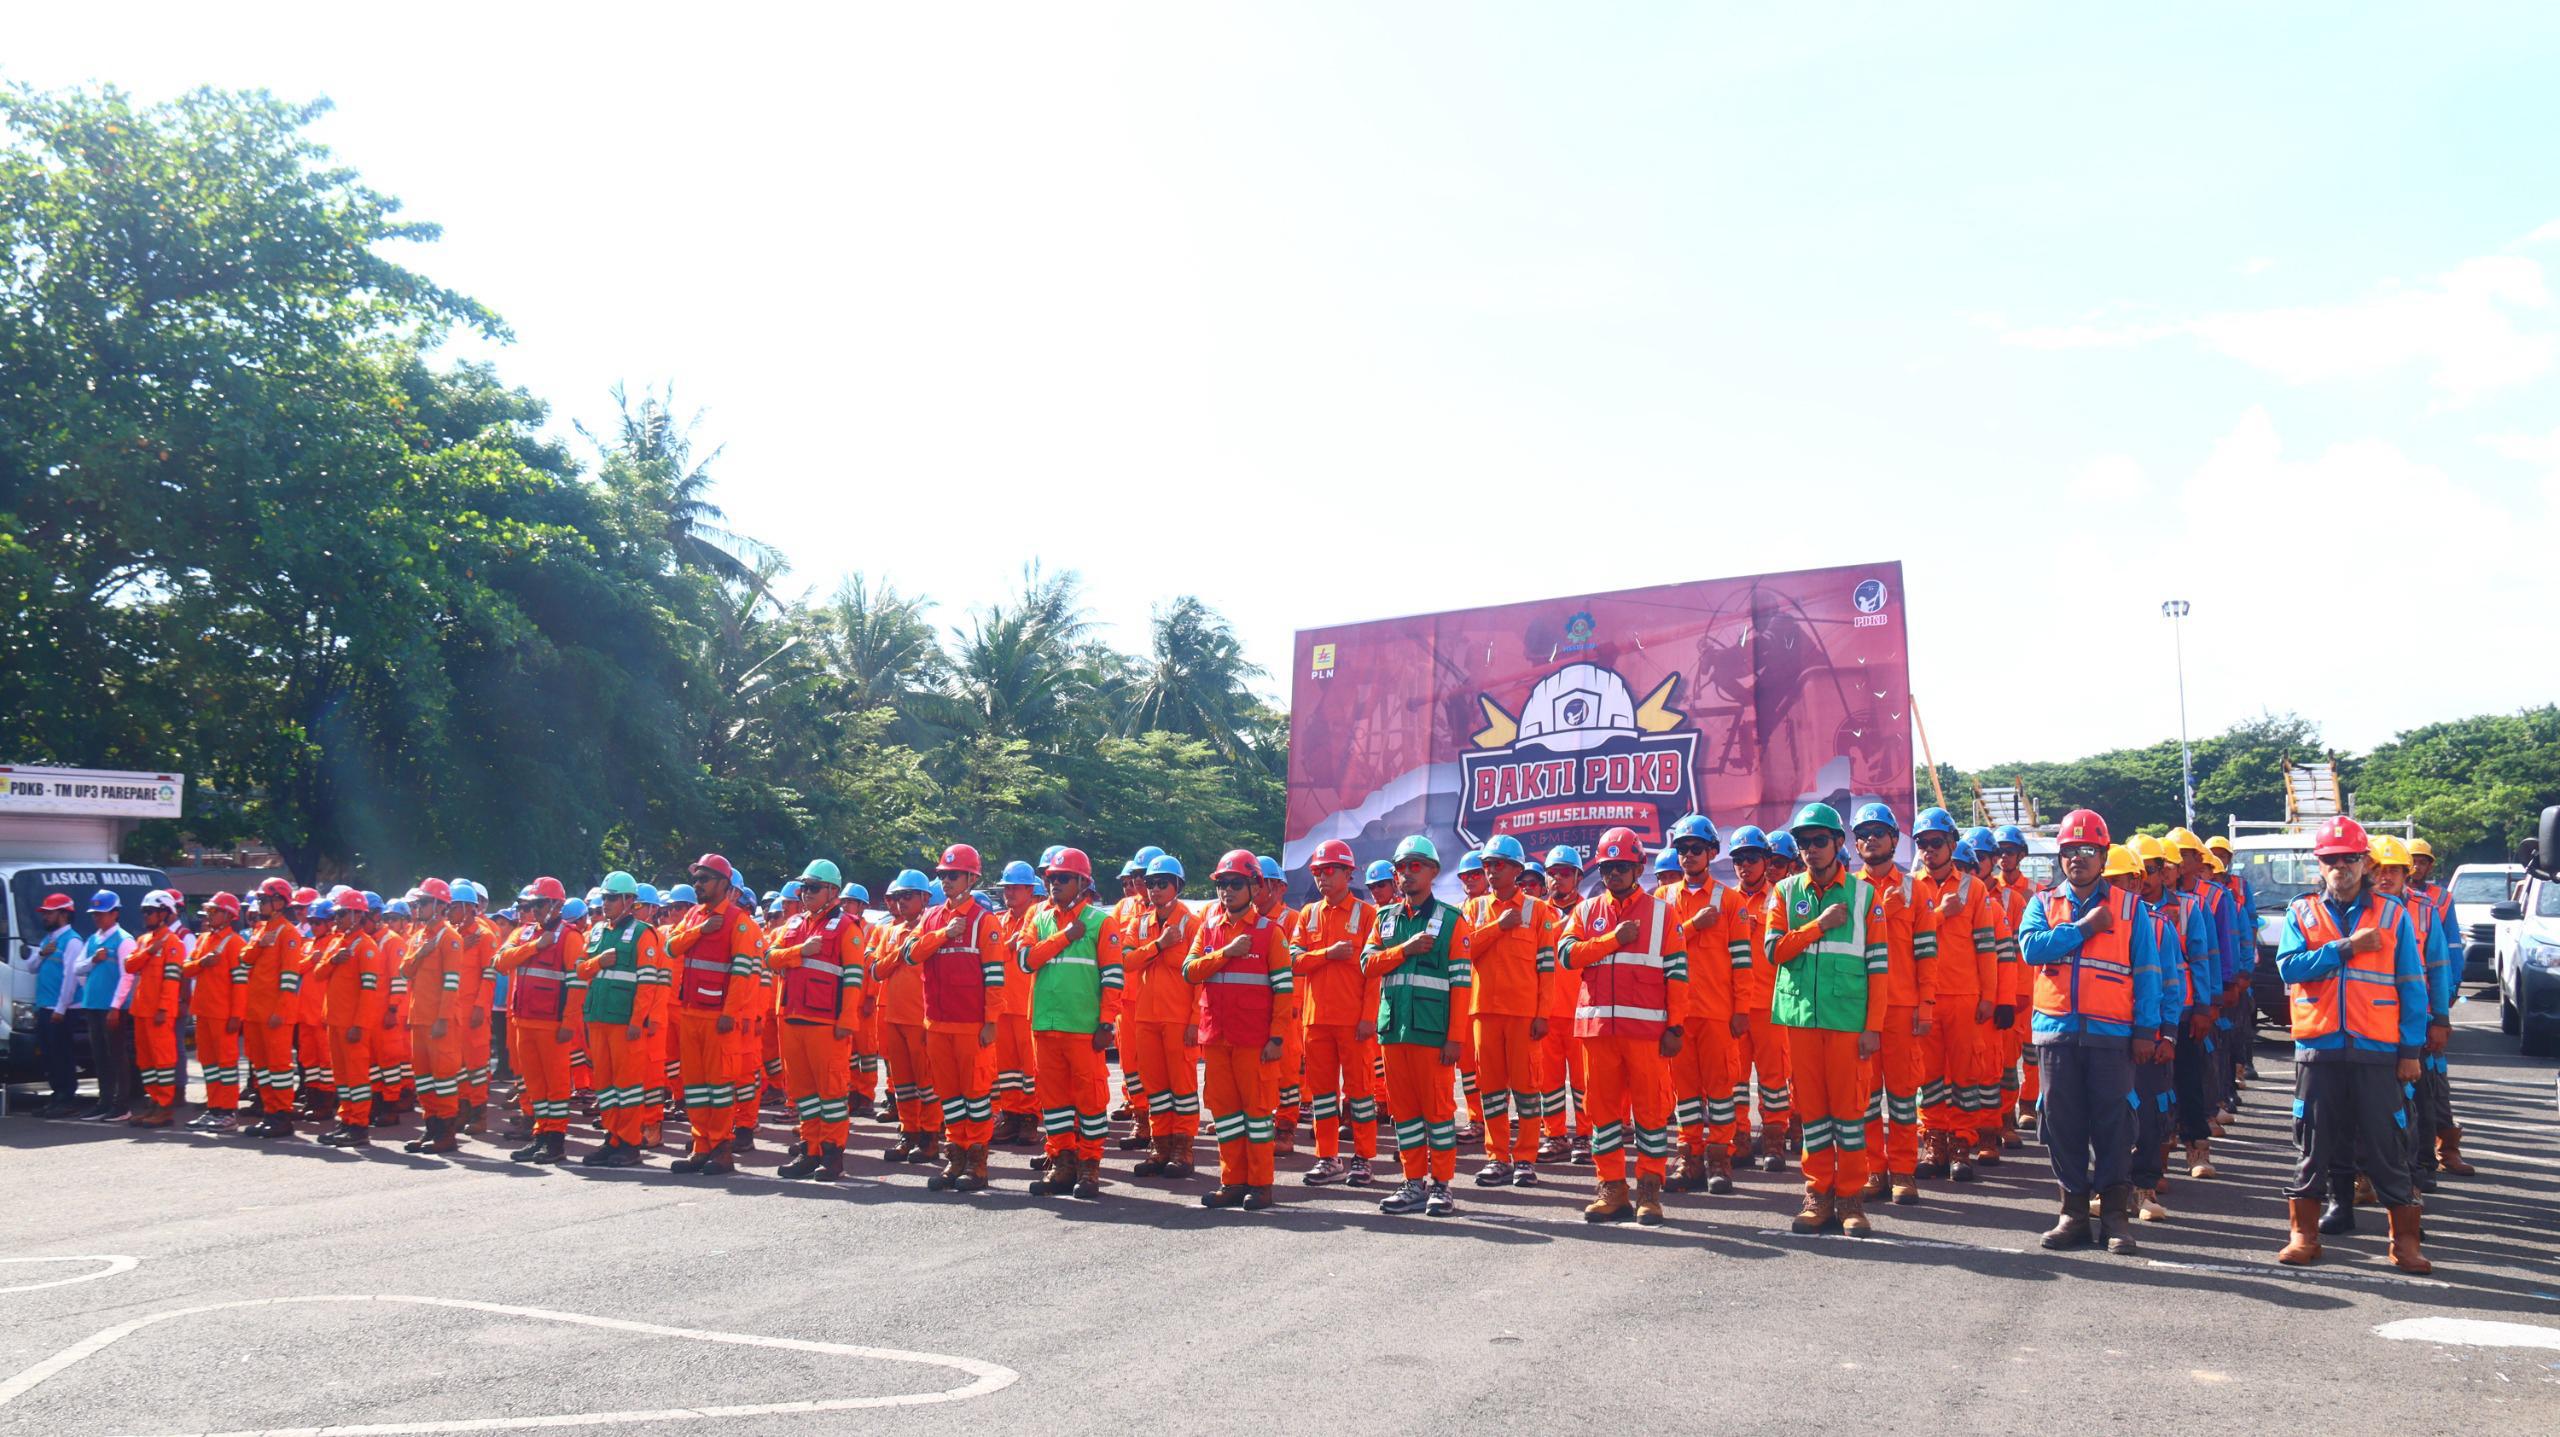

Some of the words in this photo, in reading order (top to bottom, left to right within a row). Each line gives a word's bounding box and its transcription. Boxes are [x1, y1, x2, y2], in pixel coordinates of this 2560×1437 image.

[1311, 669, 1334, 680] PLN
[10, 781, 44, 796] PDKB
[54, 783, 72, 797] TM
[75, 784, 98, 798] UP3
[101, 785, 157, 801] PAREPARE
[1473, 758, 1576, 812] BAKTI
[1583, 750, 1682, 795] PDKB
[1512, 813, 1535, 828] UID
[1539, 806, 1634, 824] SULSELRABAR
[42, 872, 98, 886] LASKAR
[101, 873, 153, 887] MADANI
